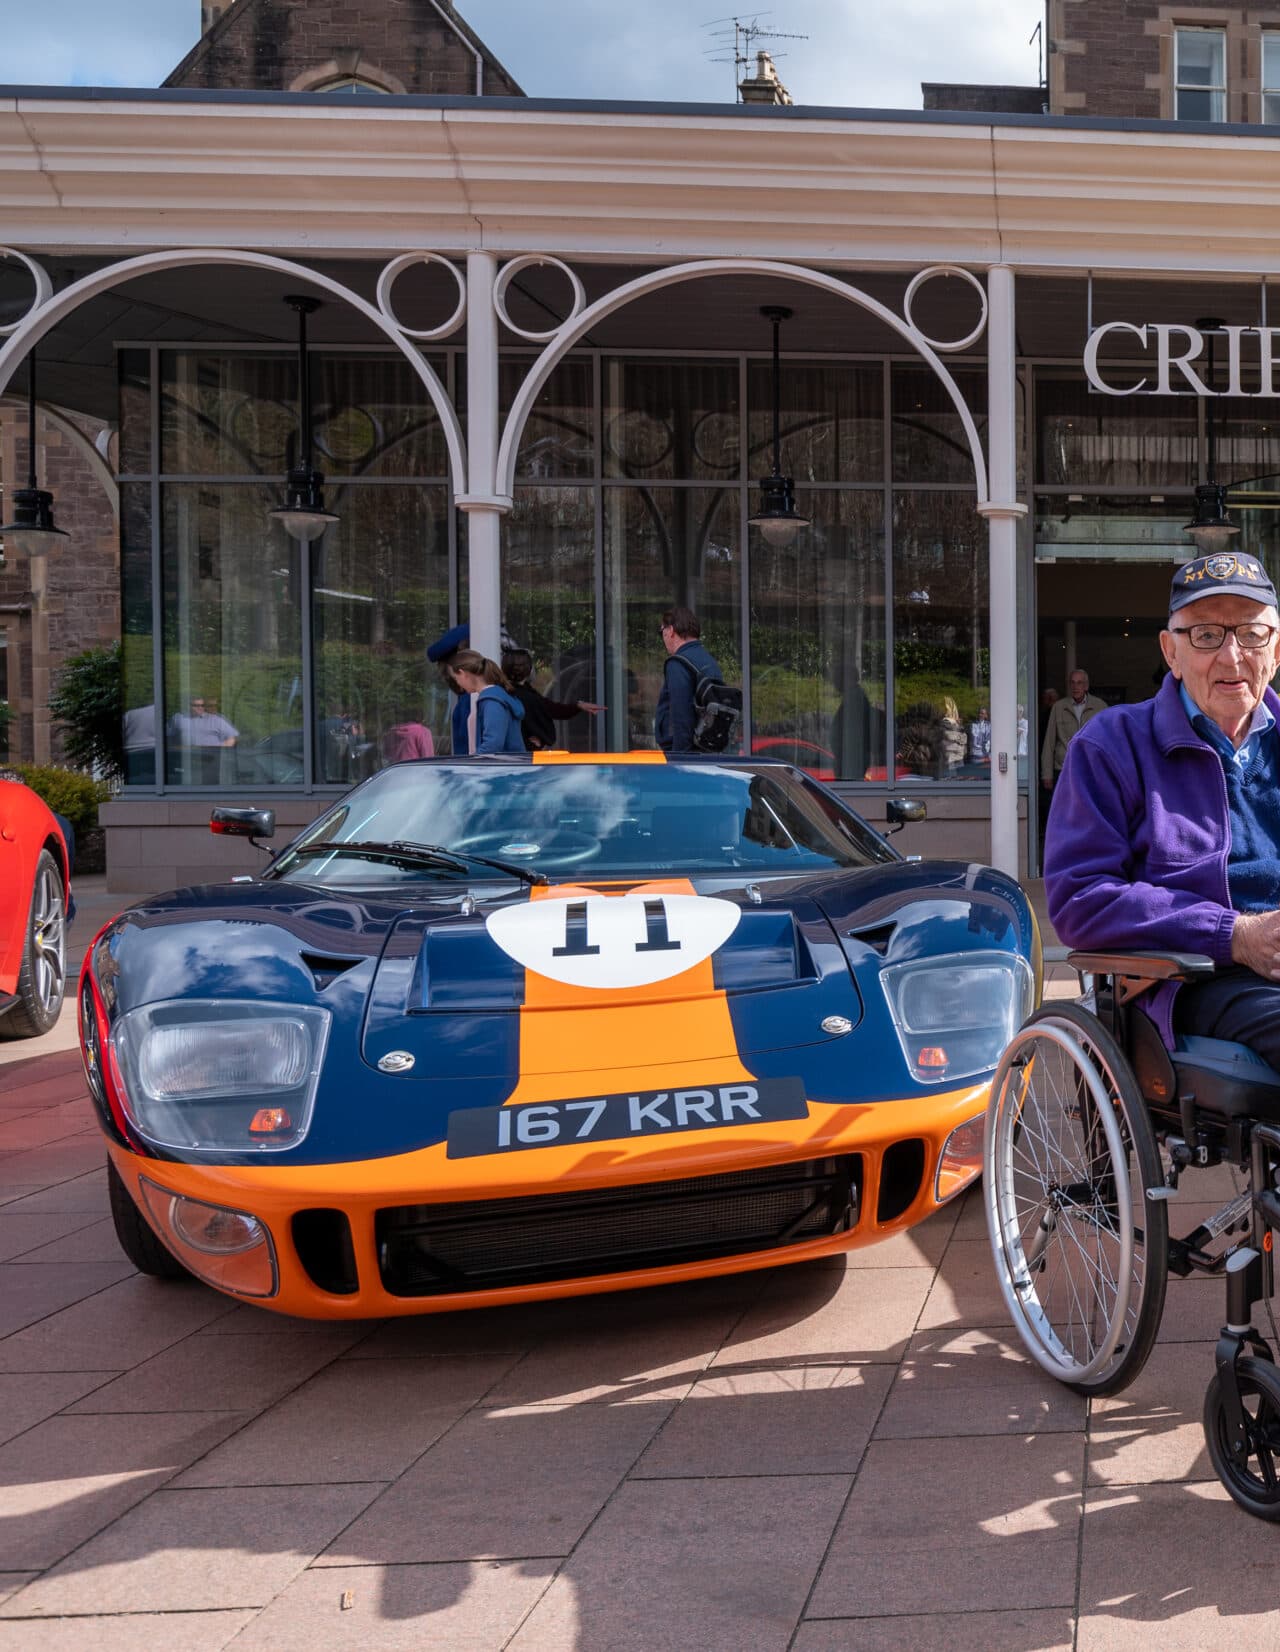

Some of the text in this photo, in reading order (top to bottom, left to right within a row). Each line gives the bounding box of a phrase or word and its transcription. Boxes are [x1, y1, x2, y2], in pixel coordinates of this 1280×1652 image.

[552, 898, 681, 957] 11
[498, 1085, 762, 1147] 167 KRR
